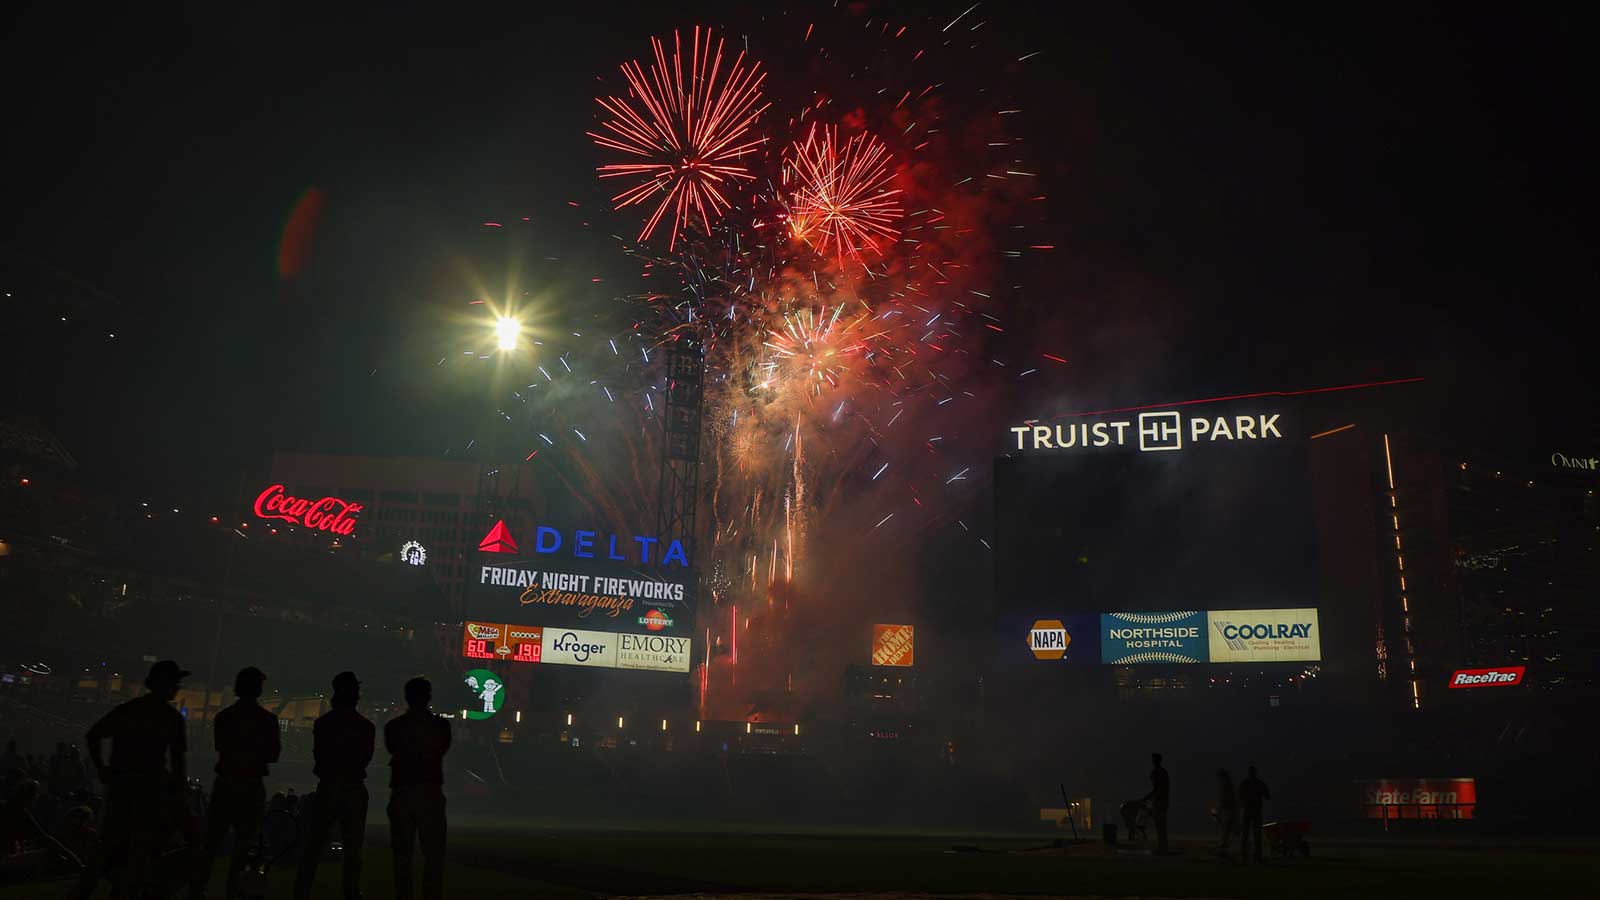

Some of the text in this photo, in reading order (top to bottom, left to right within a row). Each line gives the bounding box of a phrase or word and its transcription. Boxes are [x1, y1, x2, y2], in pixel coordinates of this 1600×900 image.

[1011, 414, 1282, 449] TRUIST PARK
[254, 484, 364, 535] Coca-Cola
[535, 526, 689, 567] DELTA
[481, 566, 684, 601] FRIDAY NIGHT FIREWORKS
[520, 583, 634, 617] Extravaganza
[639, 618, 673, 626] LOTTERY
[1033, 631, 1064, 648] NAPA
[1110, 627, 1199, 640] NORTHSIDE
[1223, 623, 1312, 640] COOLRAY
[467, 640, 486, 652] 60
[519, 643, 540, 656] 190
[553, 632, 606, 662] Kroger
[621, 635, 687, 653] EMORY
[873, 626, 912, 664] HOME
[1126, 640, 1183, 648] HOSPITAL
[1454, 672, 1516, 684] RaceTrac
[1412, 786, 1456, 804] Farm
